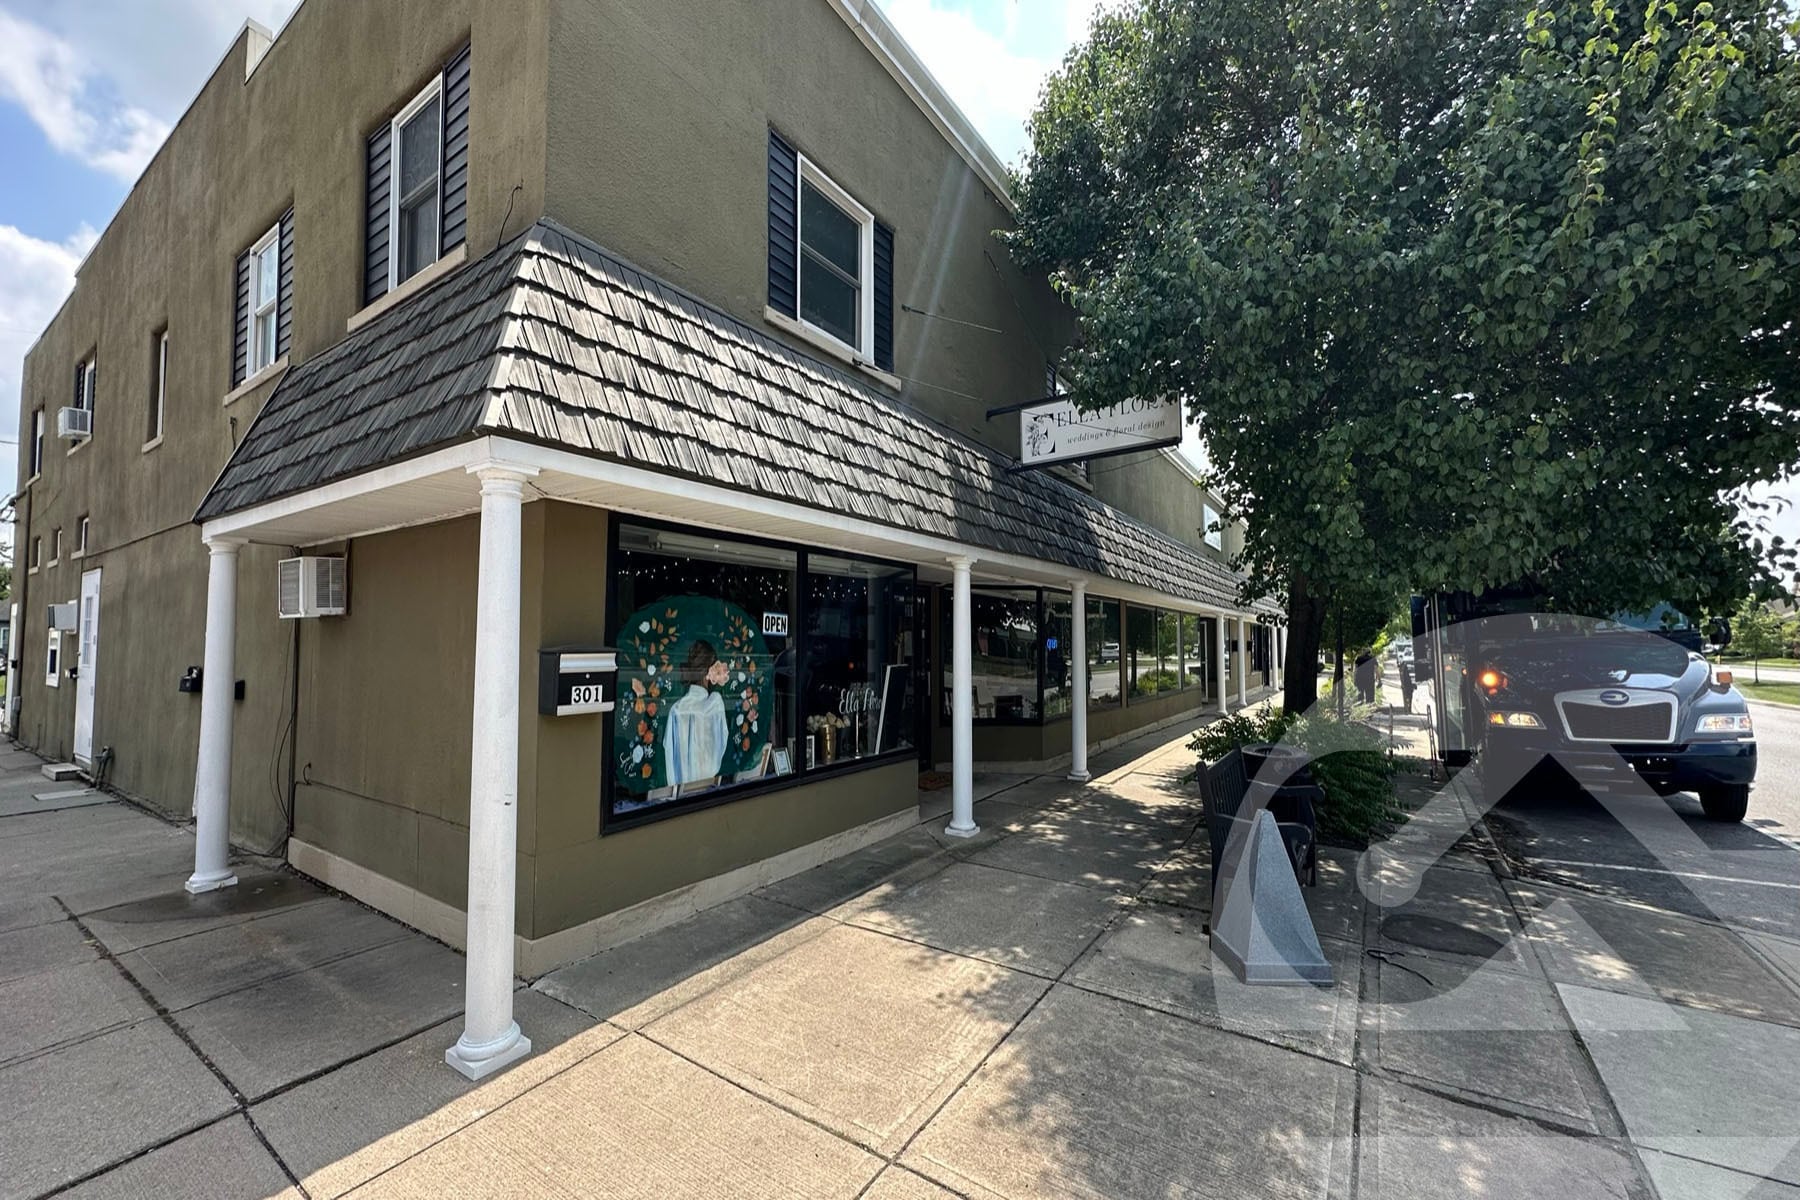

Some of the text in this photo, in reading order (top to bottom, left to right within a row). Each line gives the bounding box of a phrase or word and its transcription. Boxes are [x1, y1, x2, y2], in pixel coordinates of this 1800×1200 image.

[1067, 430, 1103, 444] weddings
[1113, 423, 1136, 438] floral
[1137, 419, 1165, 431] design
[764, 615, 787, 633] OPEN
[573, 686, 600, 703] 301
[839, 688, 859, 714] Ella
